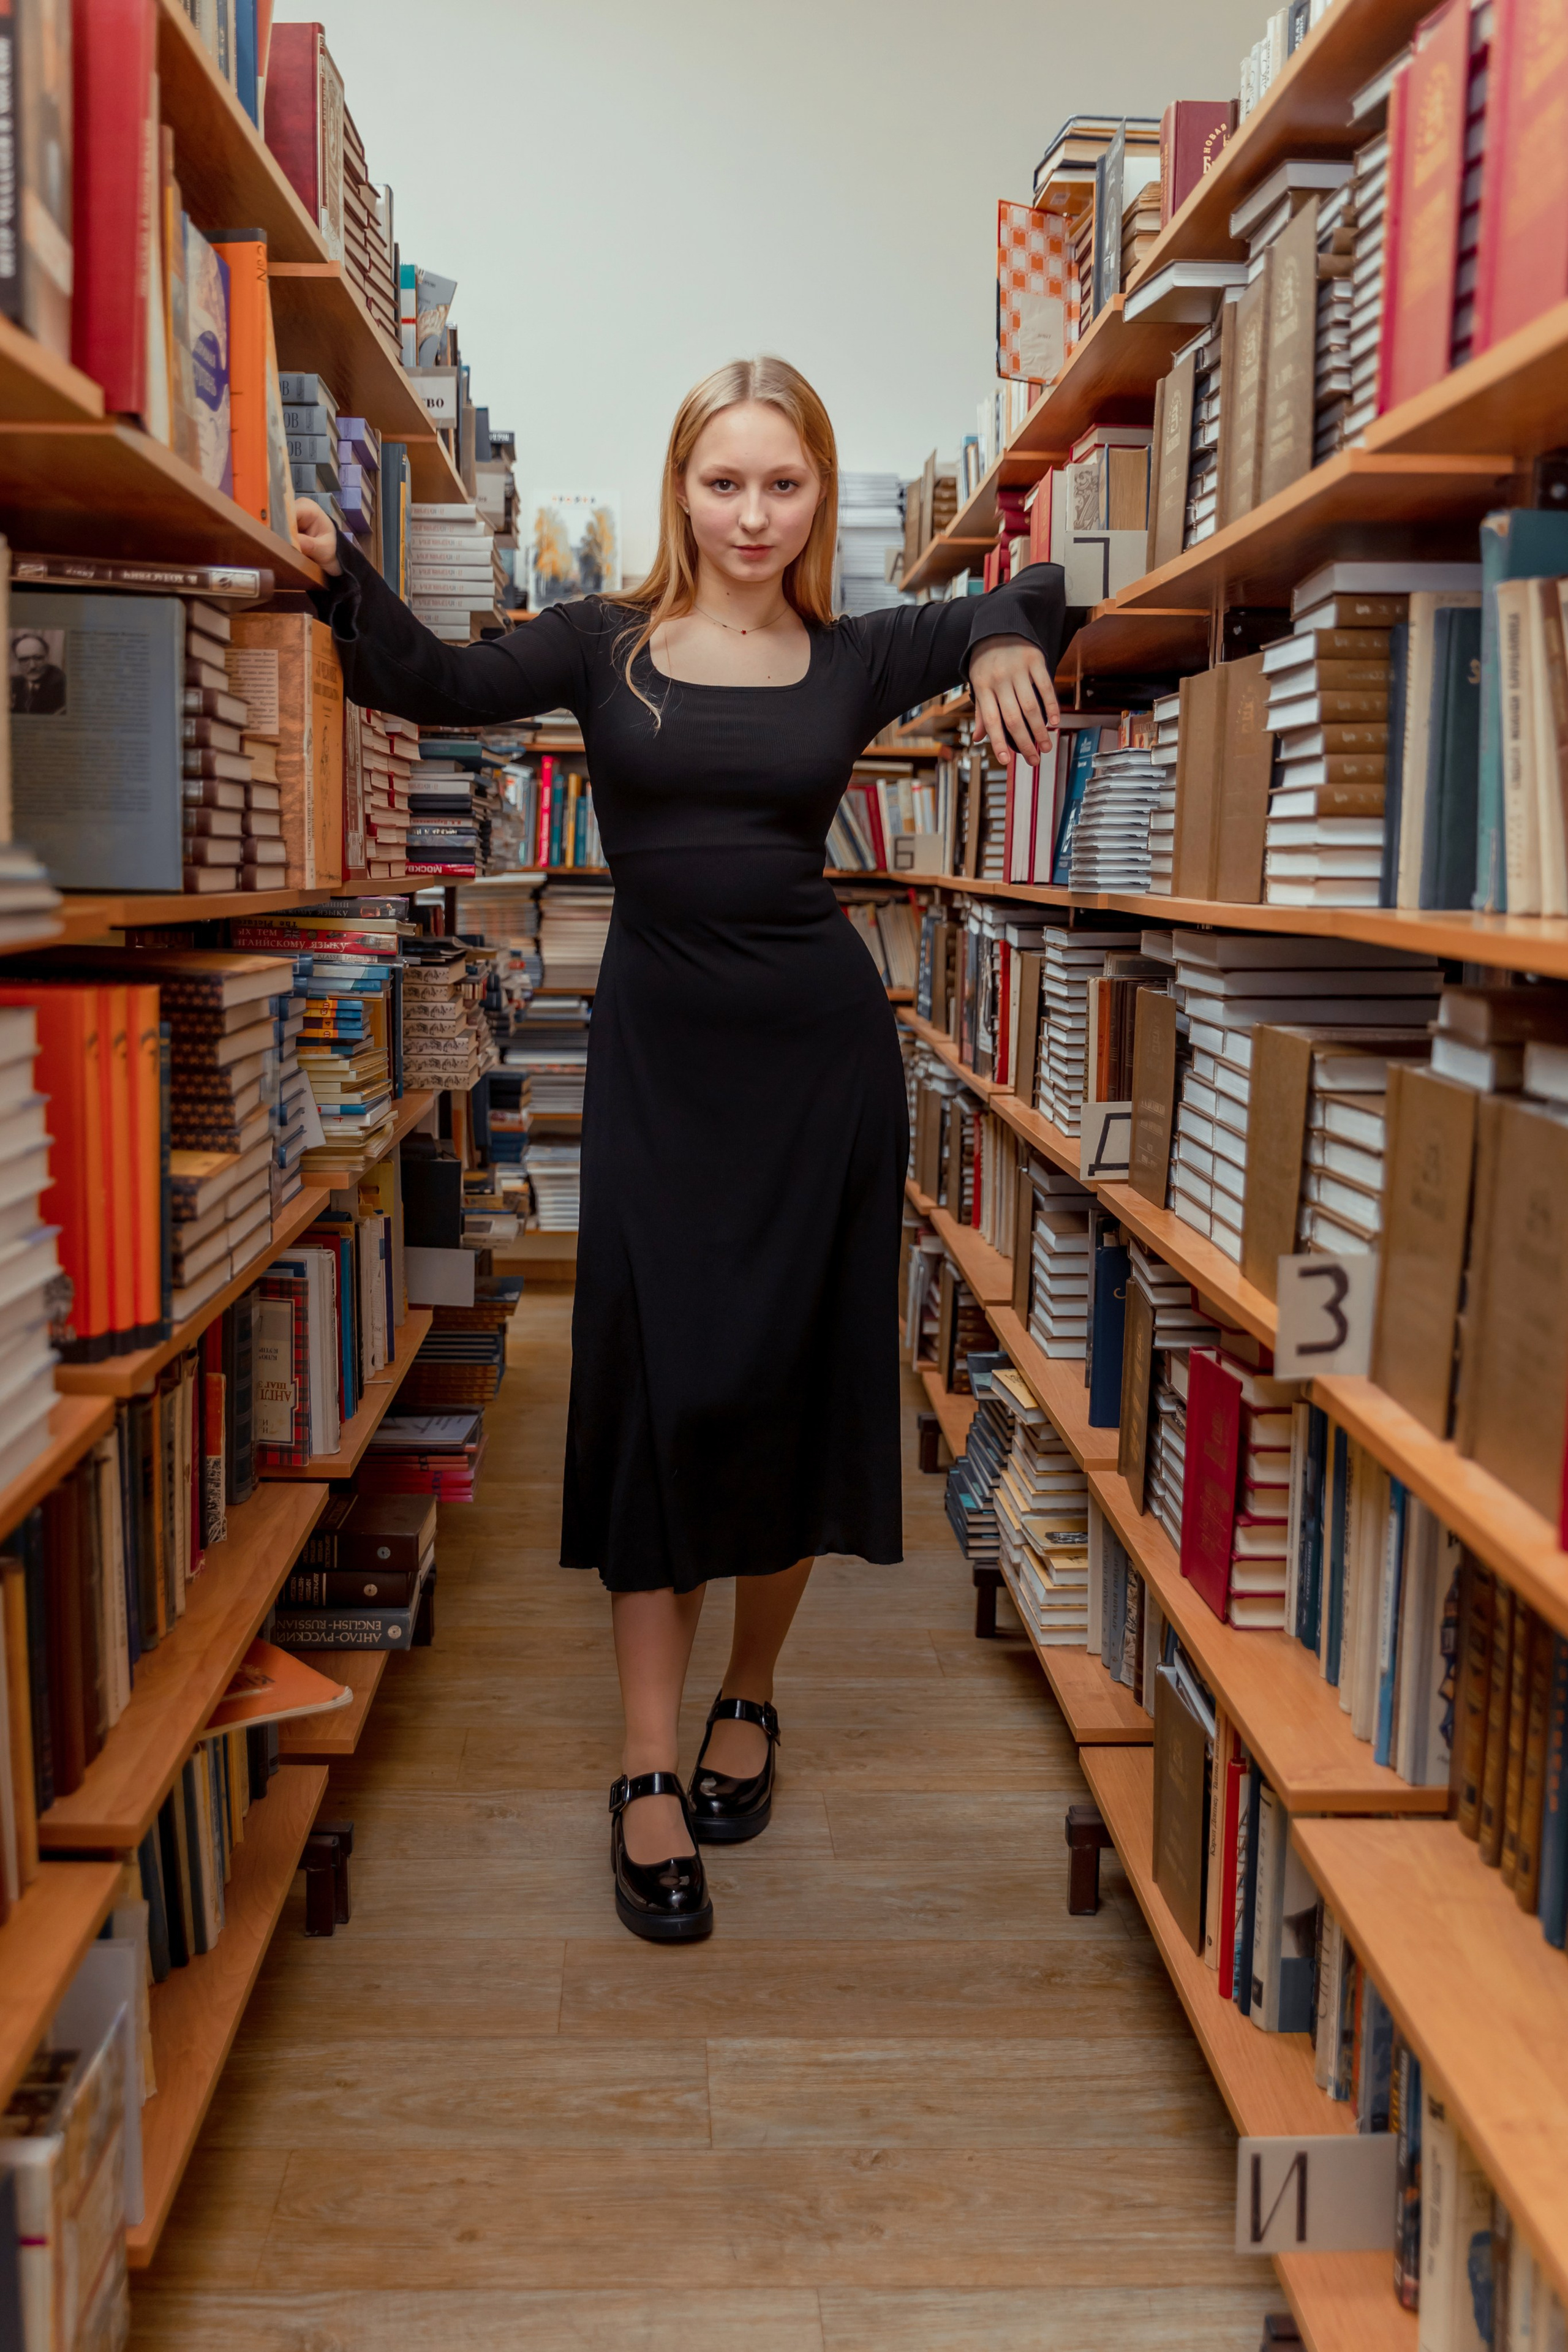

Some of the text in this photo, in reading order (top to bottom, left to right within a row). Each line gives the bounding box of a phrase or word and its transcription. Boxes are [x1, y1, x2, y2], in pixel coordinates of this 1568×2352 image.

[1203, 123, 1227, 154] НОВАЯ
[317, 909, 349, 918] языку
[309, 941, 350, 952] языку
[264, 1381, 287, 1390] ШАГ
[276, 1631, 382, 1643] АНГЛО-РУССКИЙ
[1250, 2150, 1308, 2244] И
